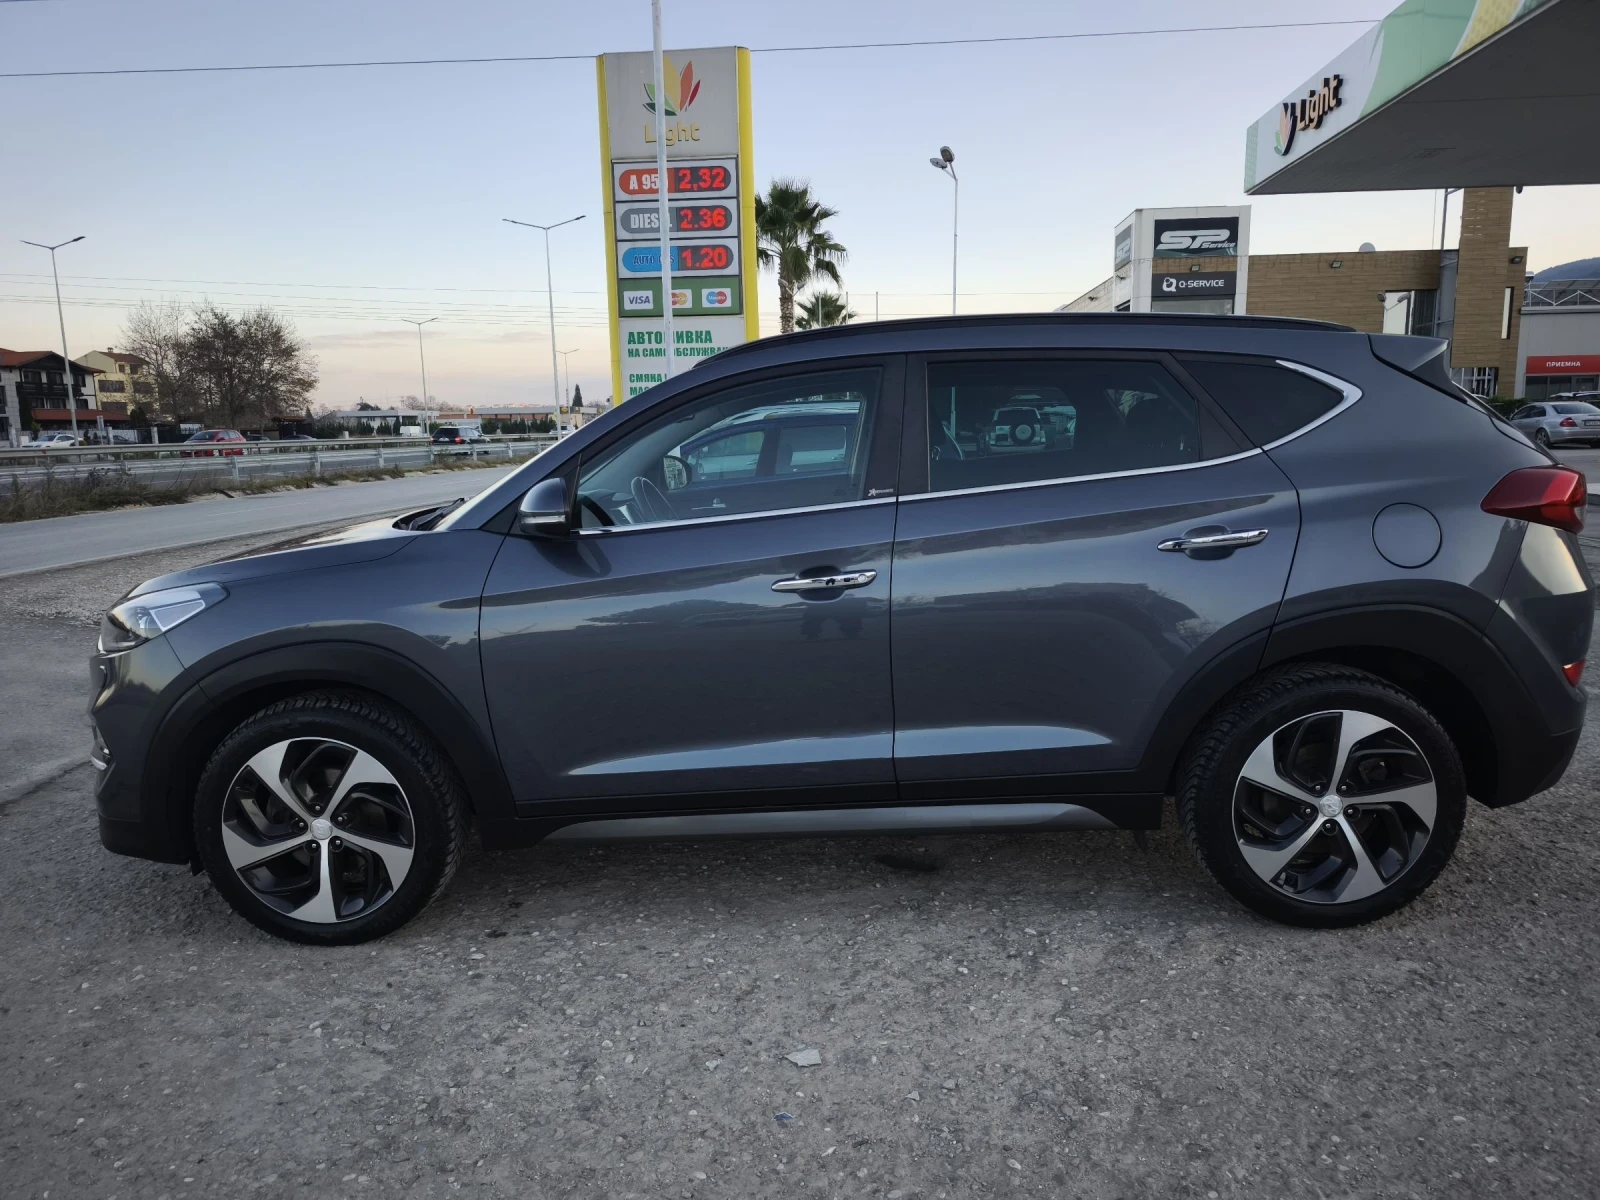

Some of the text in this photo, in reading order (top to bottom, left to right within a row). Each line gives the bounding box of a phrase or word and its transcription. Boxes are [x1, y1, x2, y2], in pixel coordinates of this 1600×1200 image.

[1296, 74, 1343, 131] Light
[644, 121, 700, 146] Lght
[629, 175, 639, 190] A
[680, 207, 726, 229] 2.36
[1155, 229, 1230, 249] SP
[1200, 241, 1236, 249] Service
[632, 254, 655, 265] AUTO
[682, 247, 728, 268] 1.20
[628, 295, 651, 305] VISA
[627, 330, 713, 345] АВТОИВКА
[627, 348, 641, 358] НА
[628, 373, 663, 383] СМЯНА
